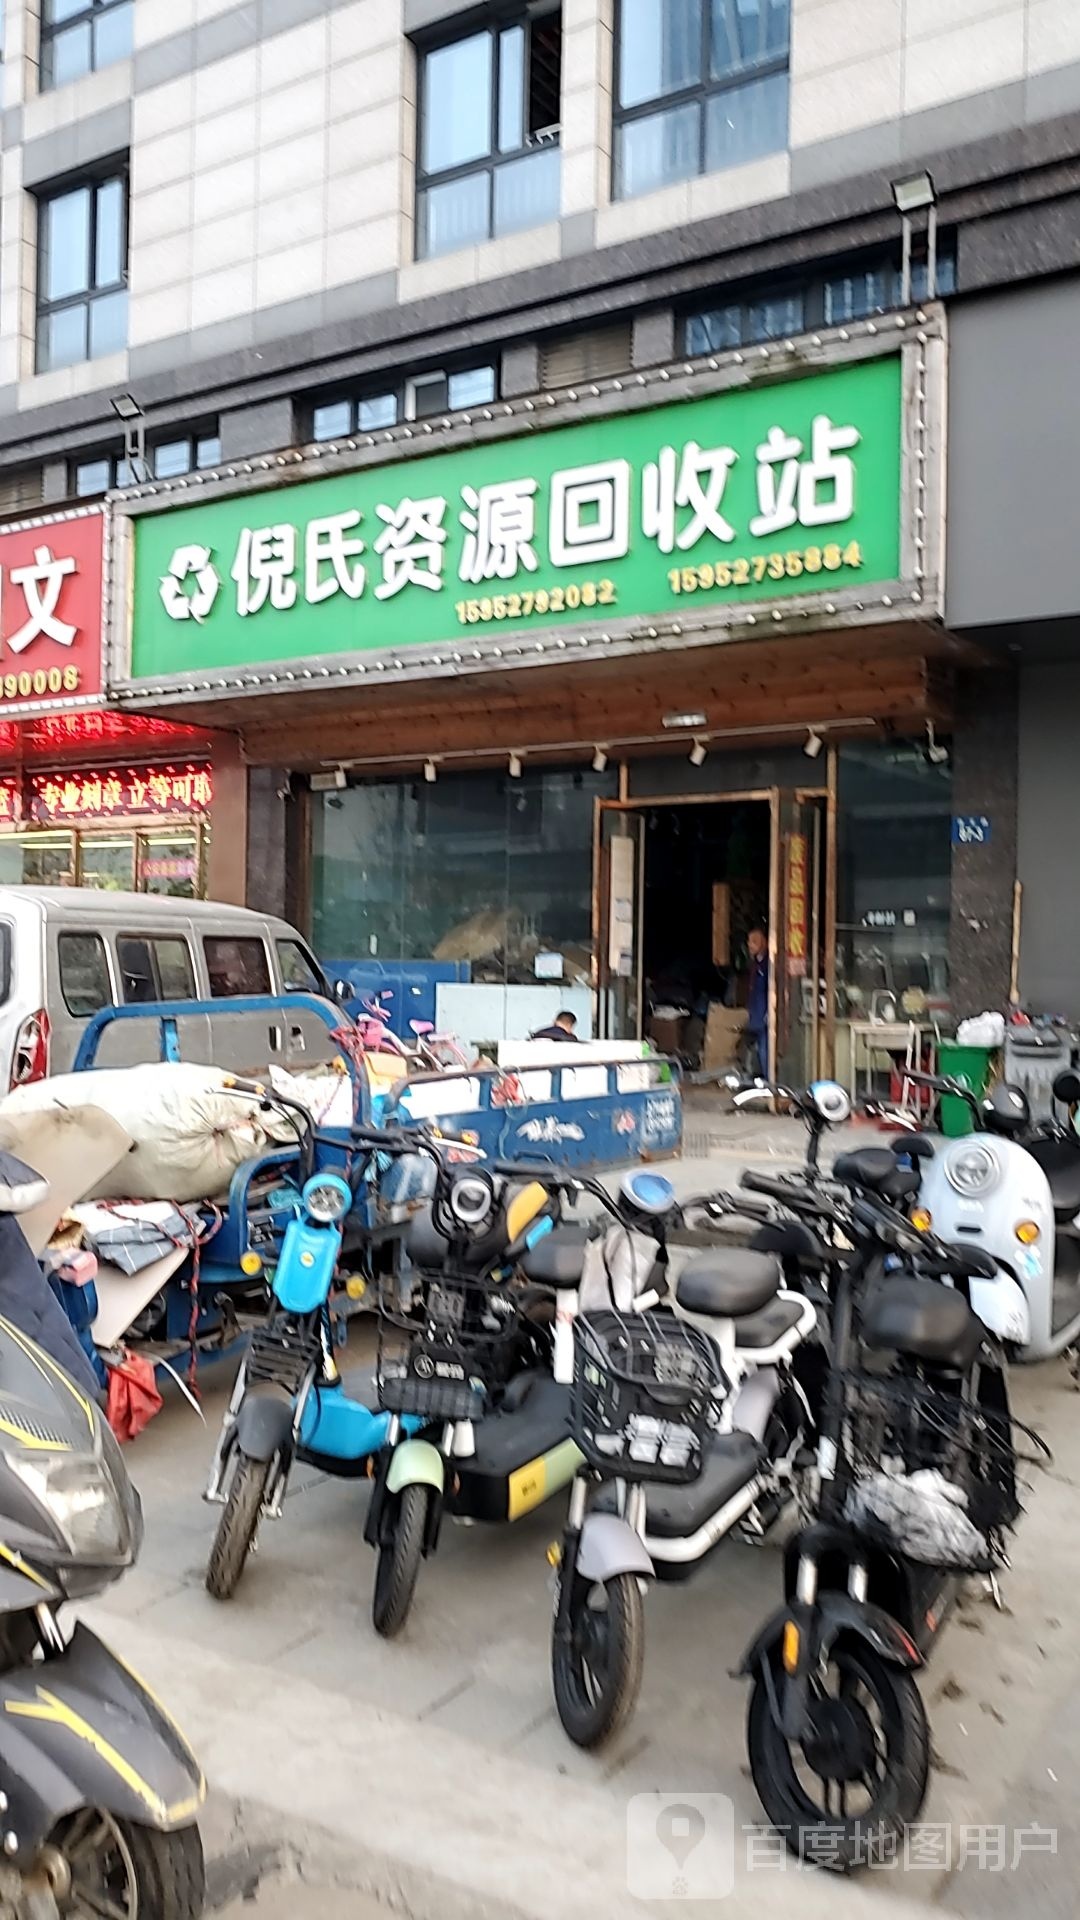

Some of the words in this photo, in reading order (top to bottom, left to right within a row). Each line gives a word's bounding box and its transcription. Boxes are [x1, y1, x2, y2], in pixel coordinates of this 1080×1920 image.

[231, 414, 861, 617] 倪氏资源回收站
[667, 540, 864, 595] 15952735884
[0, 545, 78, 654] 文
[455, 578, 618, 625] 15952792082
[0, 664, 79, 699] 90008
